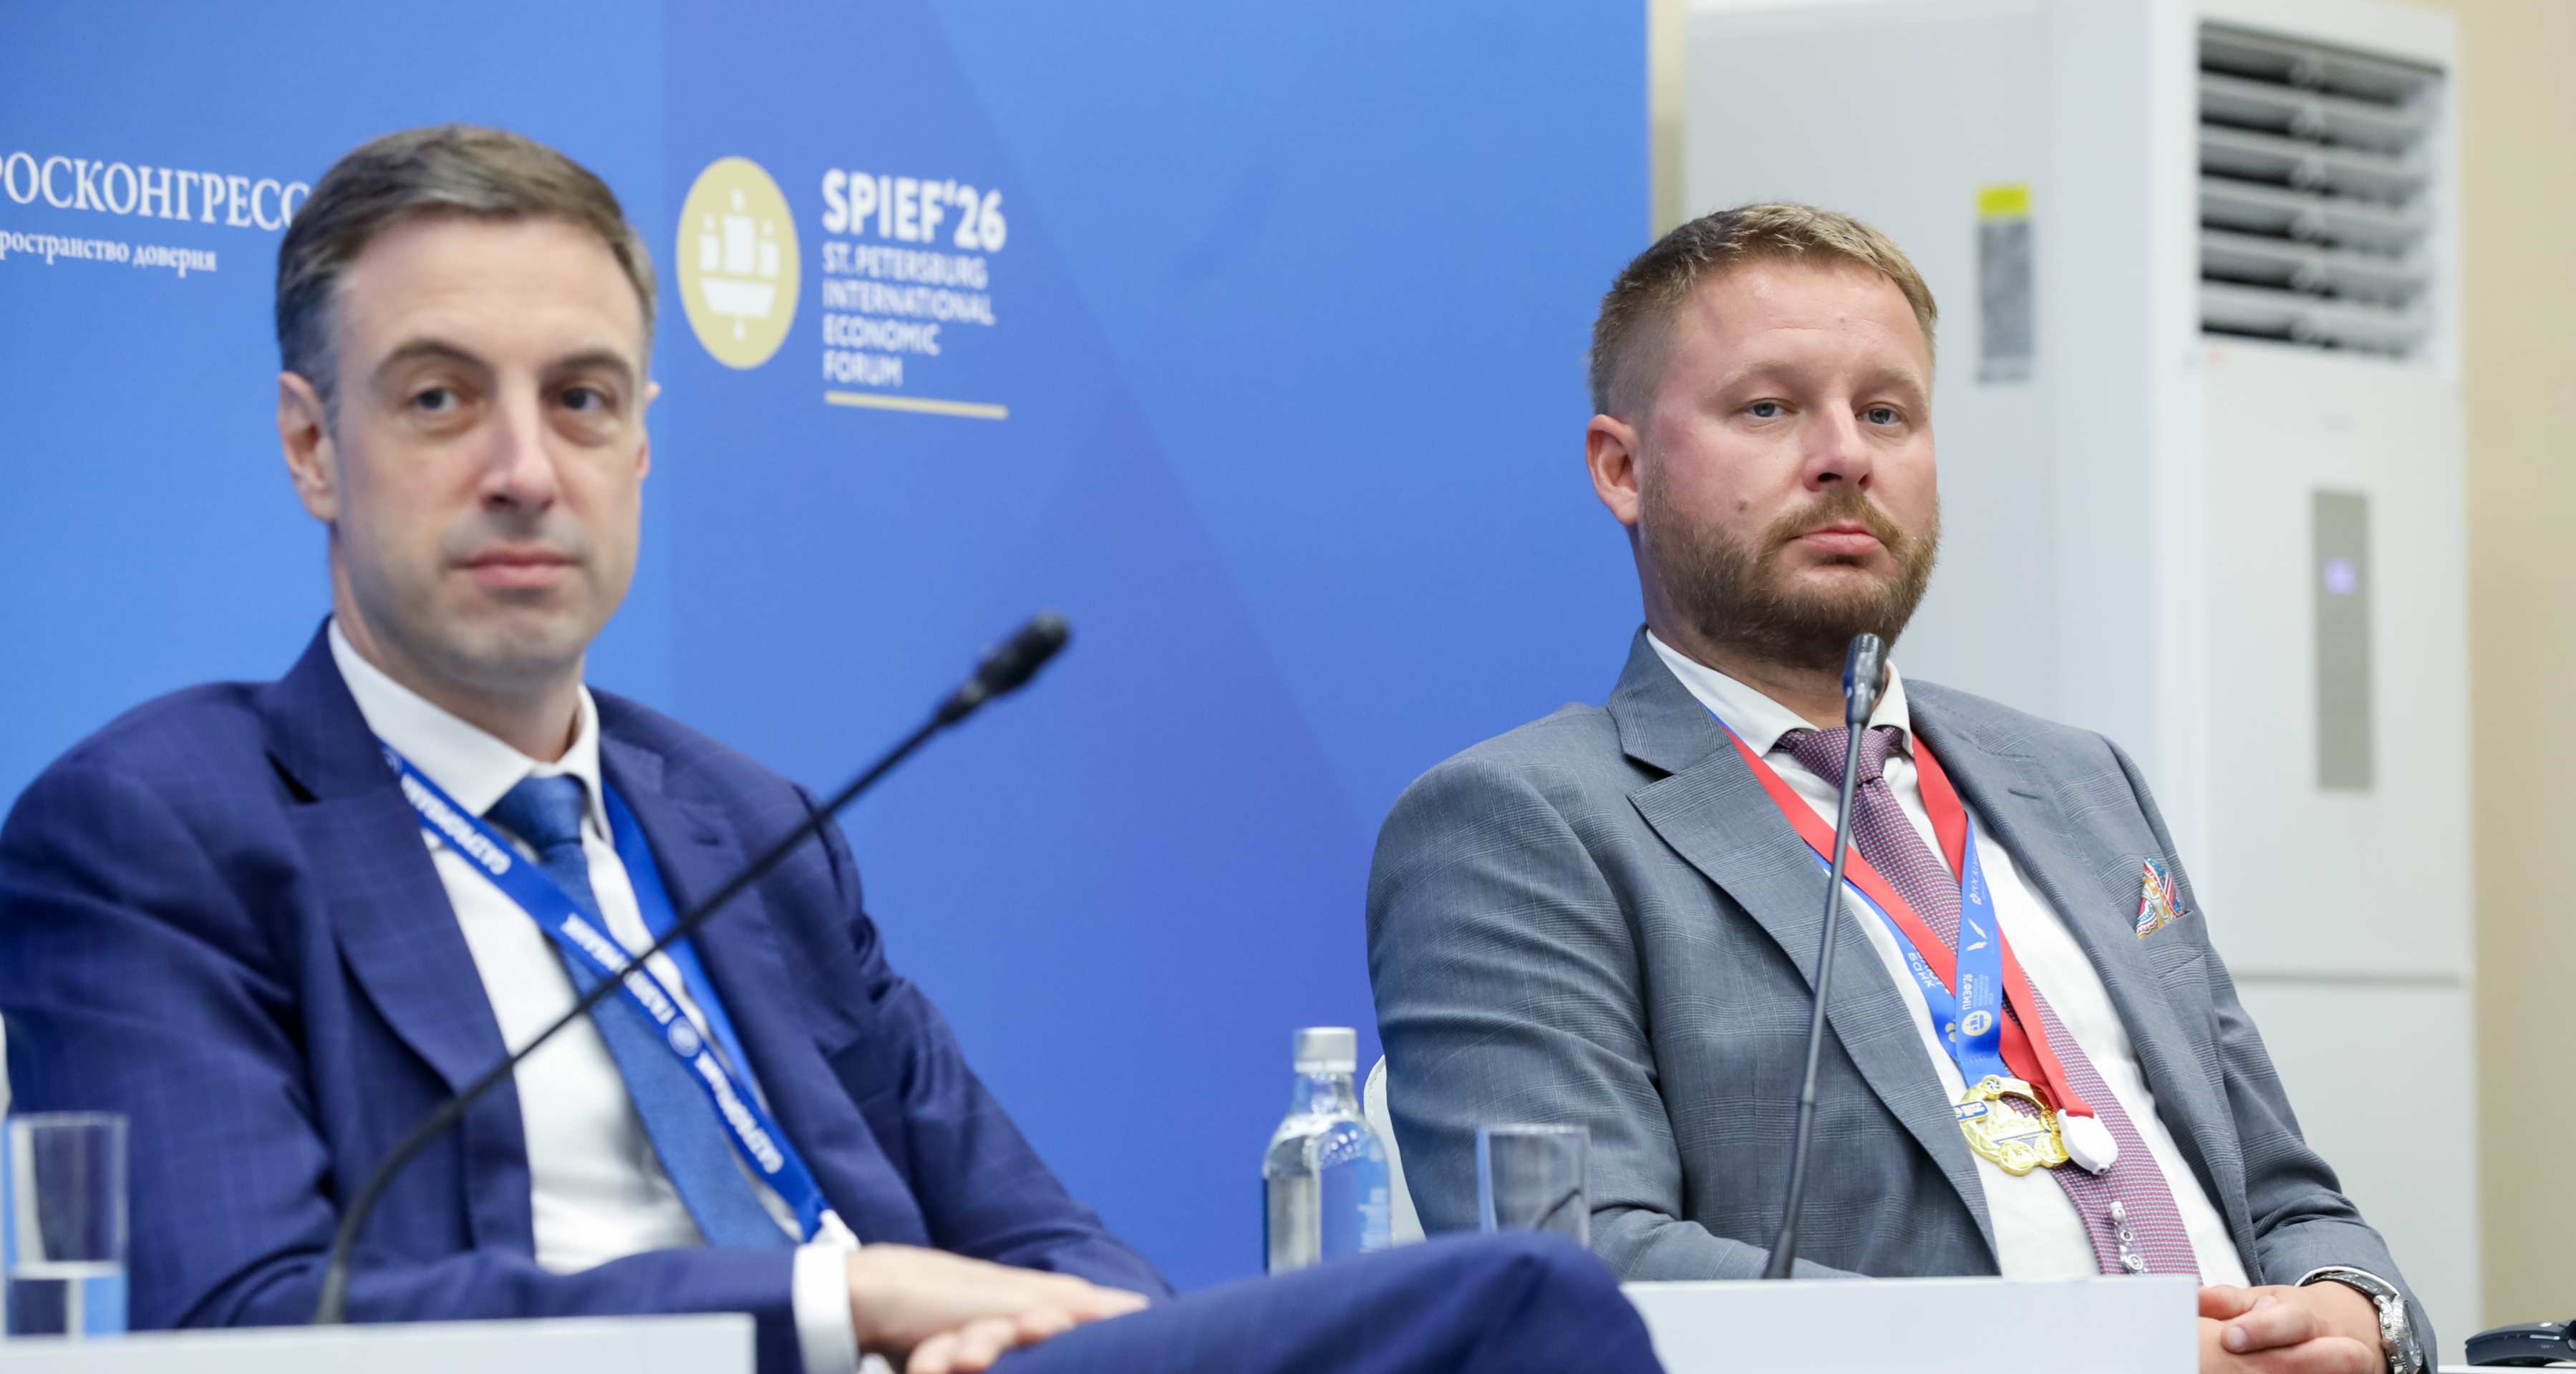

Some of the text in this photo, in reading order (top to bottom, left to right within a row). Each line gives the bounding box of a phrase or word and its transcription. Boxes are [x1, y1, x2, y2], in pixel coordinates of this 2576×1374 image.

[0, 151, 311, 231] ОСКОНГРЕСС
[133, 246, 217, 278] доверия
[822, 279, 997, 326] INTERNATIONAL
[823, 314, 941, 356] ECONOMIC
[823, 349, 903, 386] FORUM
